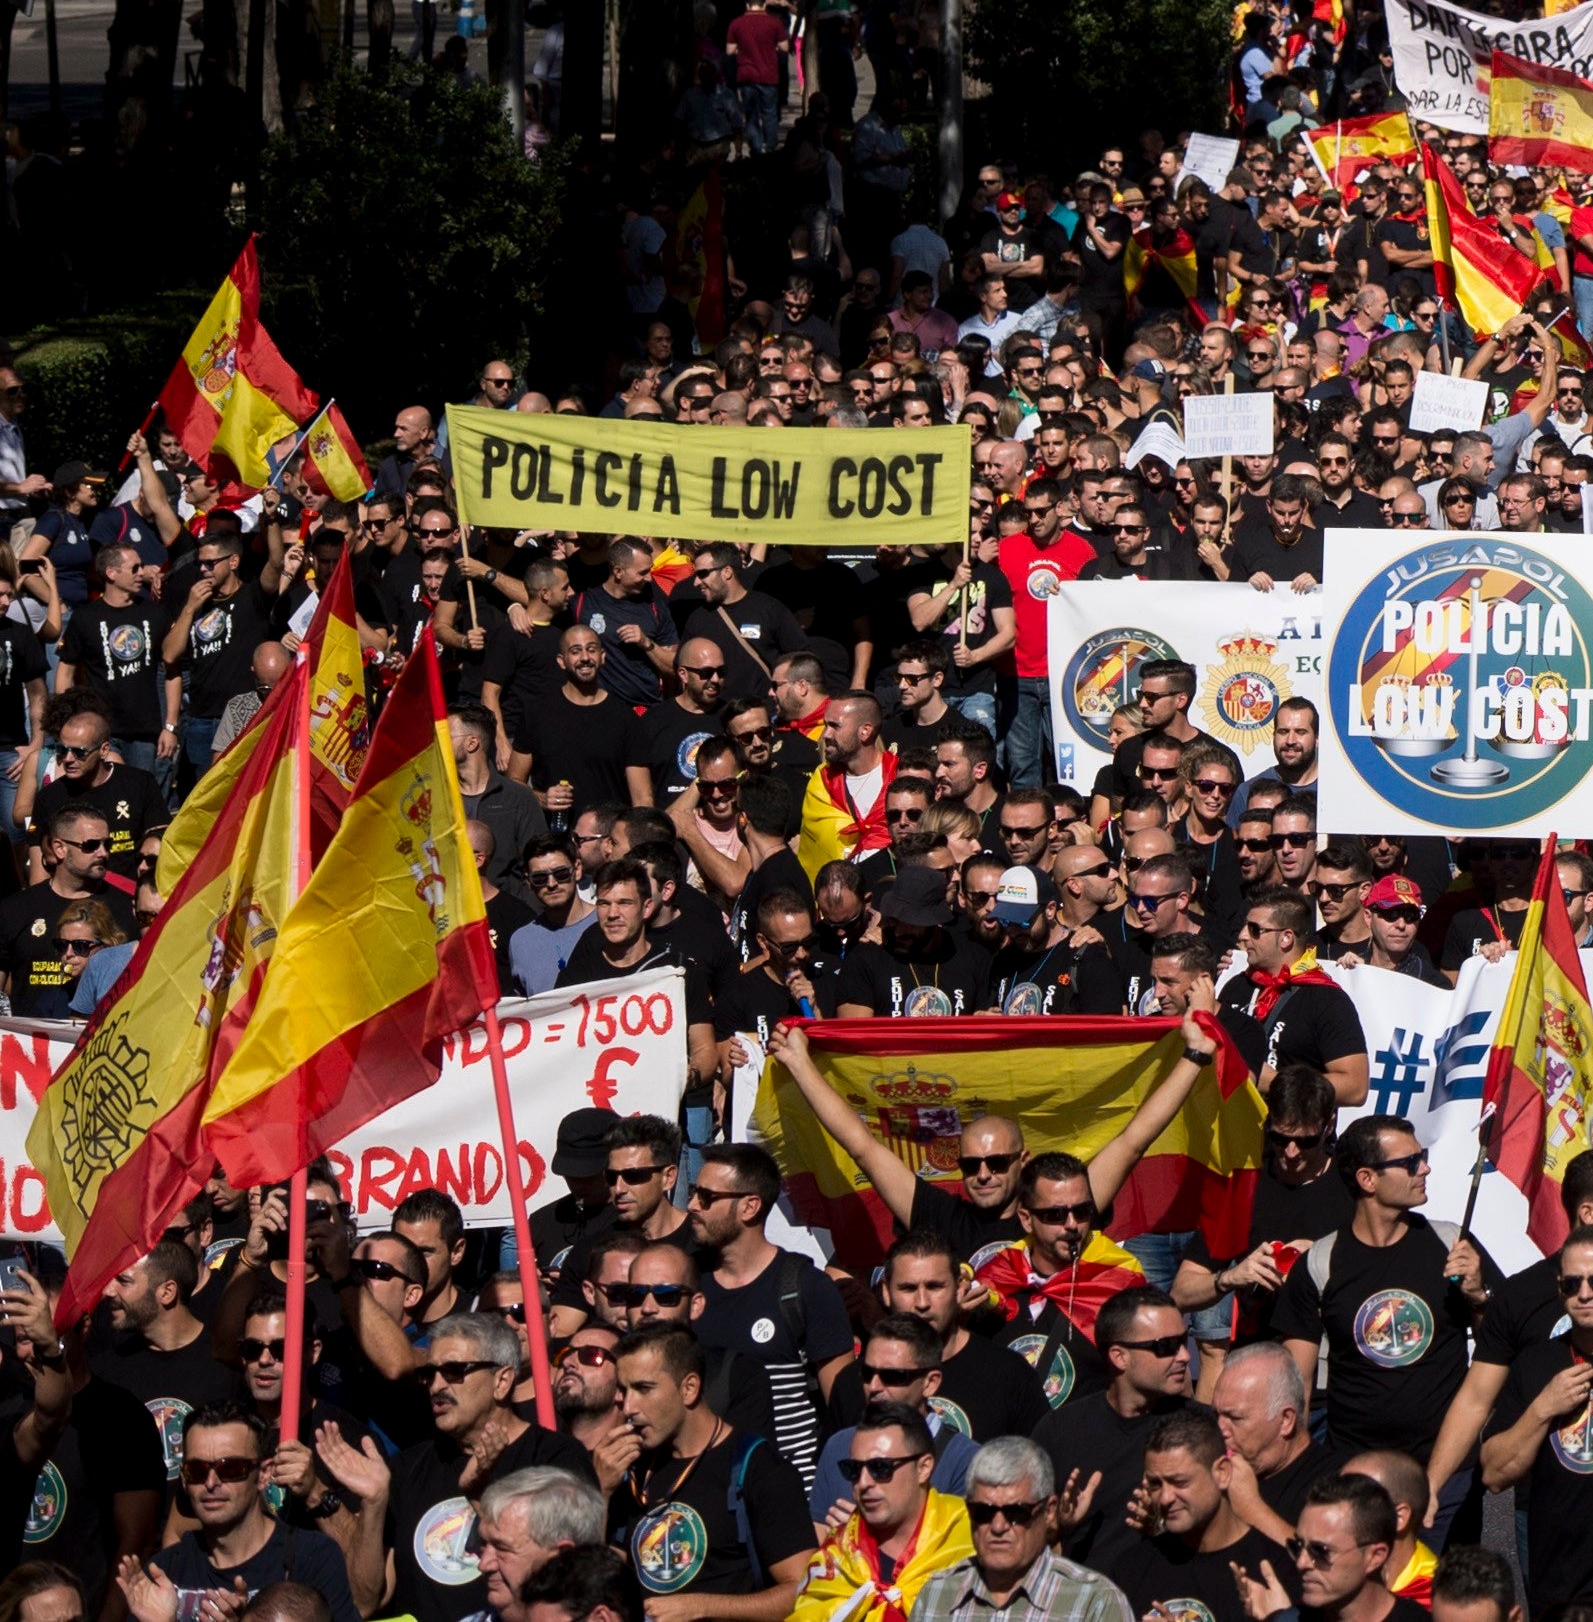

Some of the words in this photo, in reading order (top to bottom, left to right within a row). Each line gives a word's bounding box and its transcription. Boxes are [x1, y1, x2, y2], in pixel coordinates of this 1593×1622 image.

[1425, 40, 1473, 85] POR
[1464, 97, 1490, 124] ESP
[710, 457, 801, 519] LOW
[828, 454, 943, 519] COST
[1385, 544, 1570, 600] JUSAPOL
[1084, 629, 1168, 656] JUSAPOL
[1277, 617, 1302, 639] A
[1382, 599, 1573, 656] POLICIA
[1348, 682, 1454, 740] LOW
[586, 1046, 641, 1118] €
[326, 1140, 547, 1214] BRANDO
